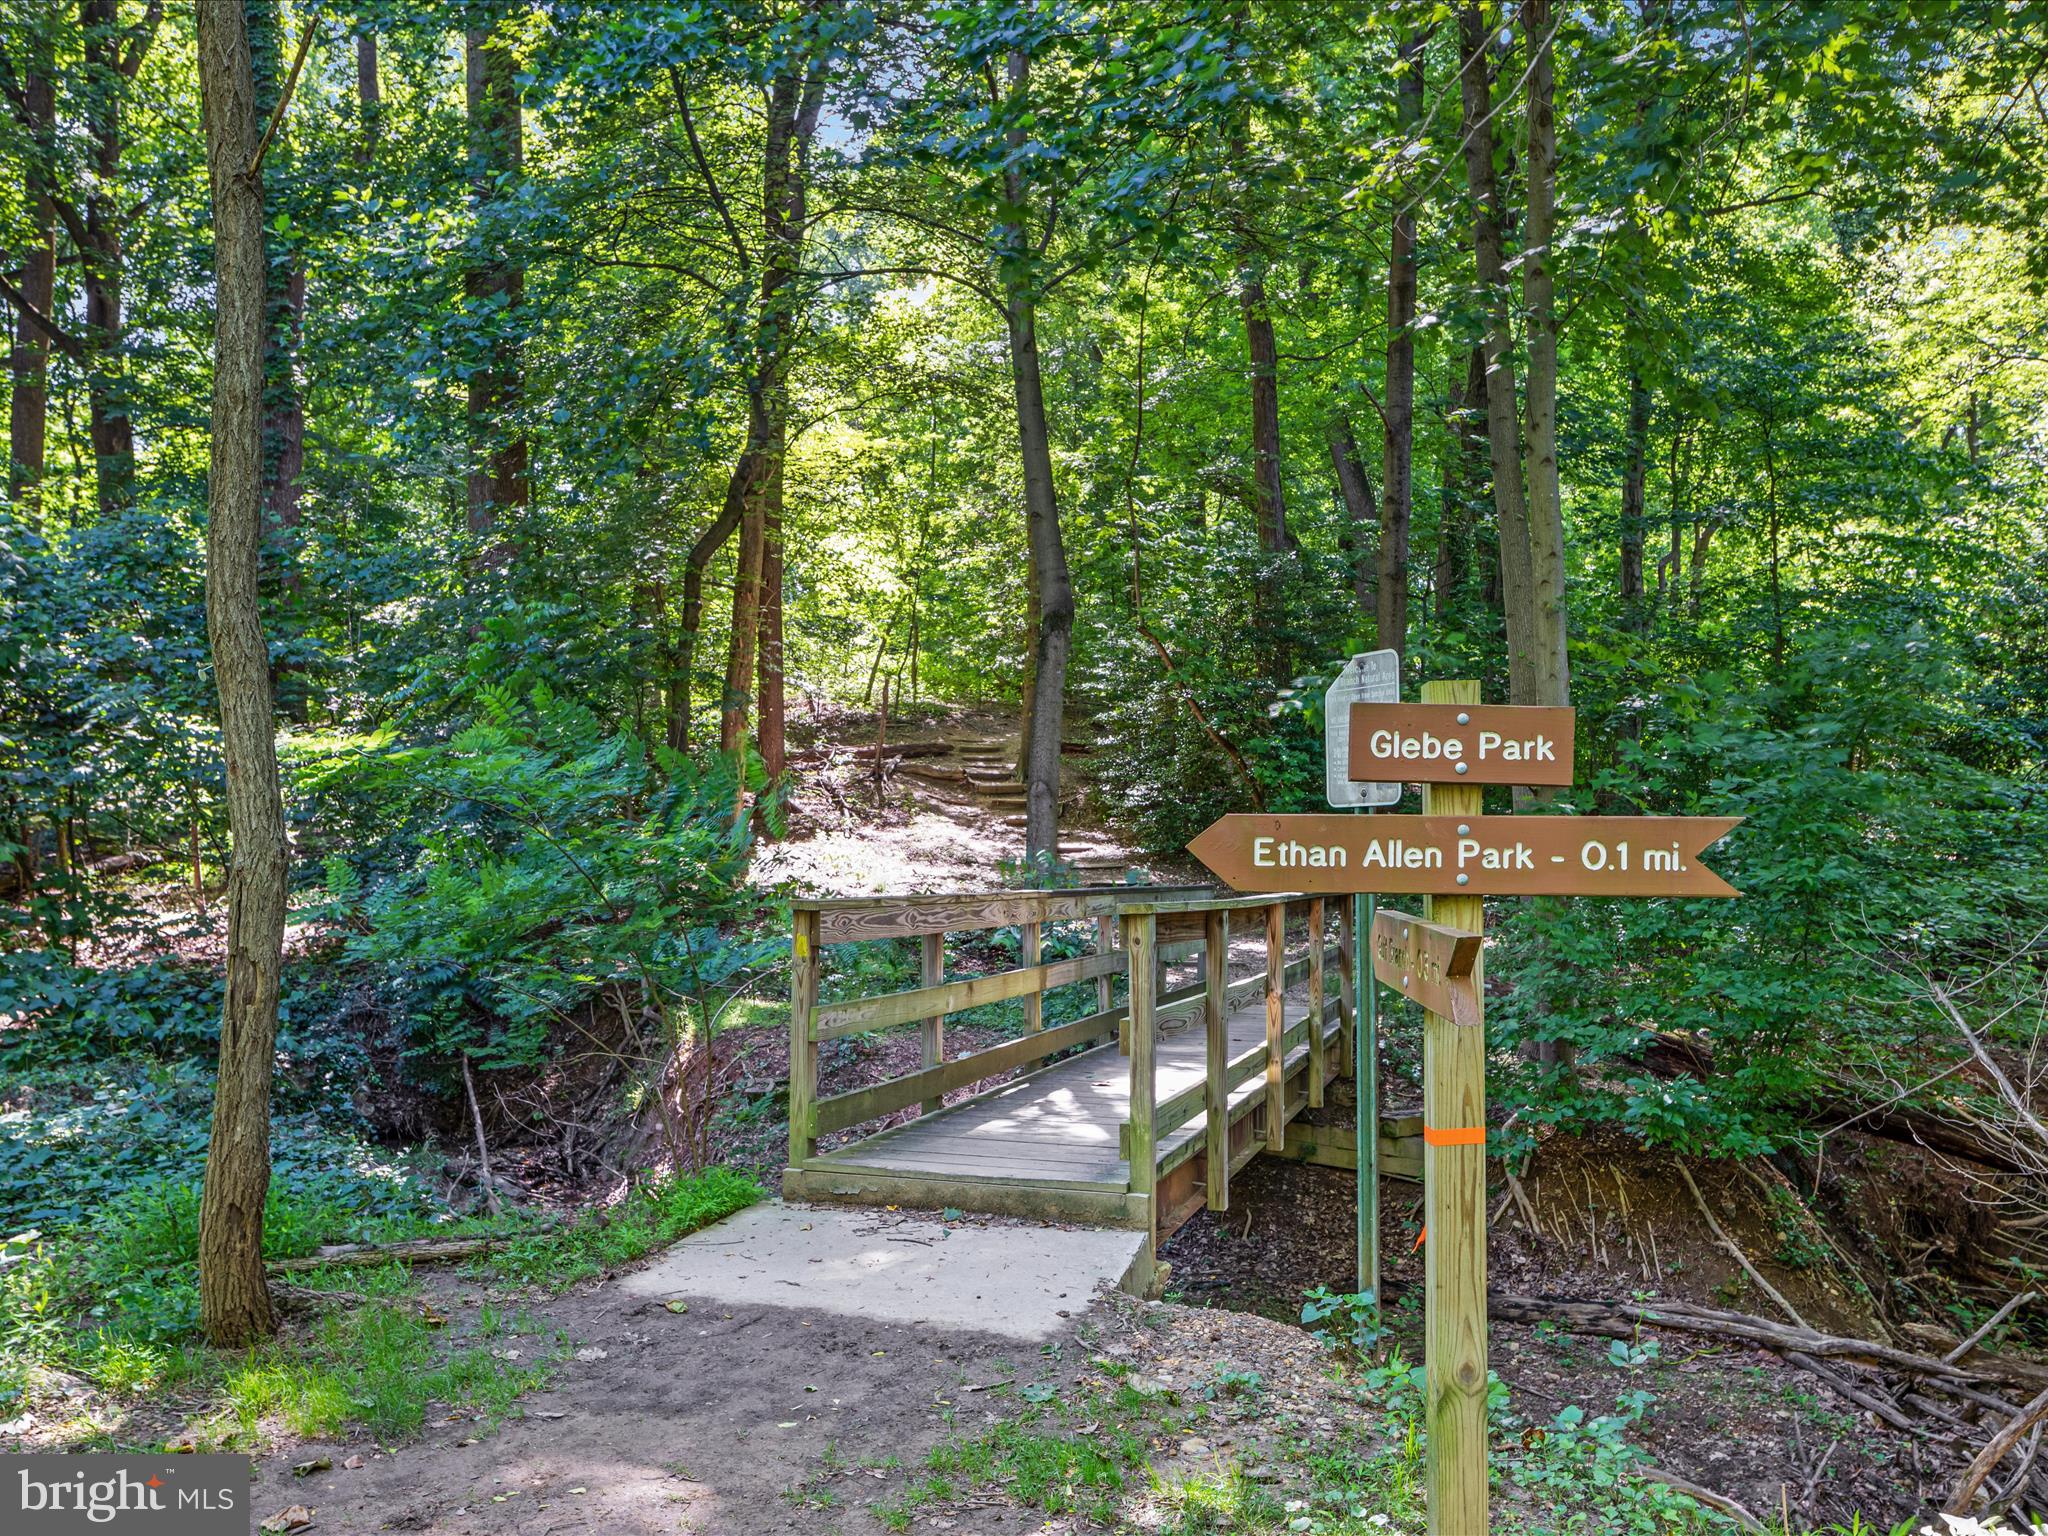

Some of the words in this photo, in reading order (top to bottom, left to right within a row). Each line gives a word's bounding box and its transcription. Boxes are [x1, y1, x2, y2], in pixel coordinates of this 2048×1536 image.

[1370, 729, 1463, 760] Glebe
[1478, 731, 1556, 761] Park
[1253, 836, 1347, 867] Ethan
[1362, 839, 1442, 868] Allen
[1457, 838, 1535, 869] Park
[1550, 855, 1565, 863] -
[1581, 840, 1629, 871] 0.1
[1643, 841, 1688, 872] mi.
